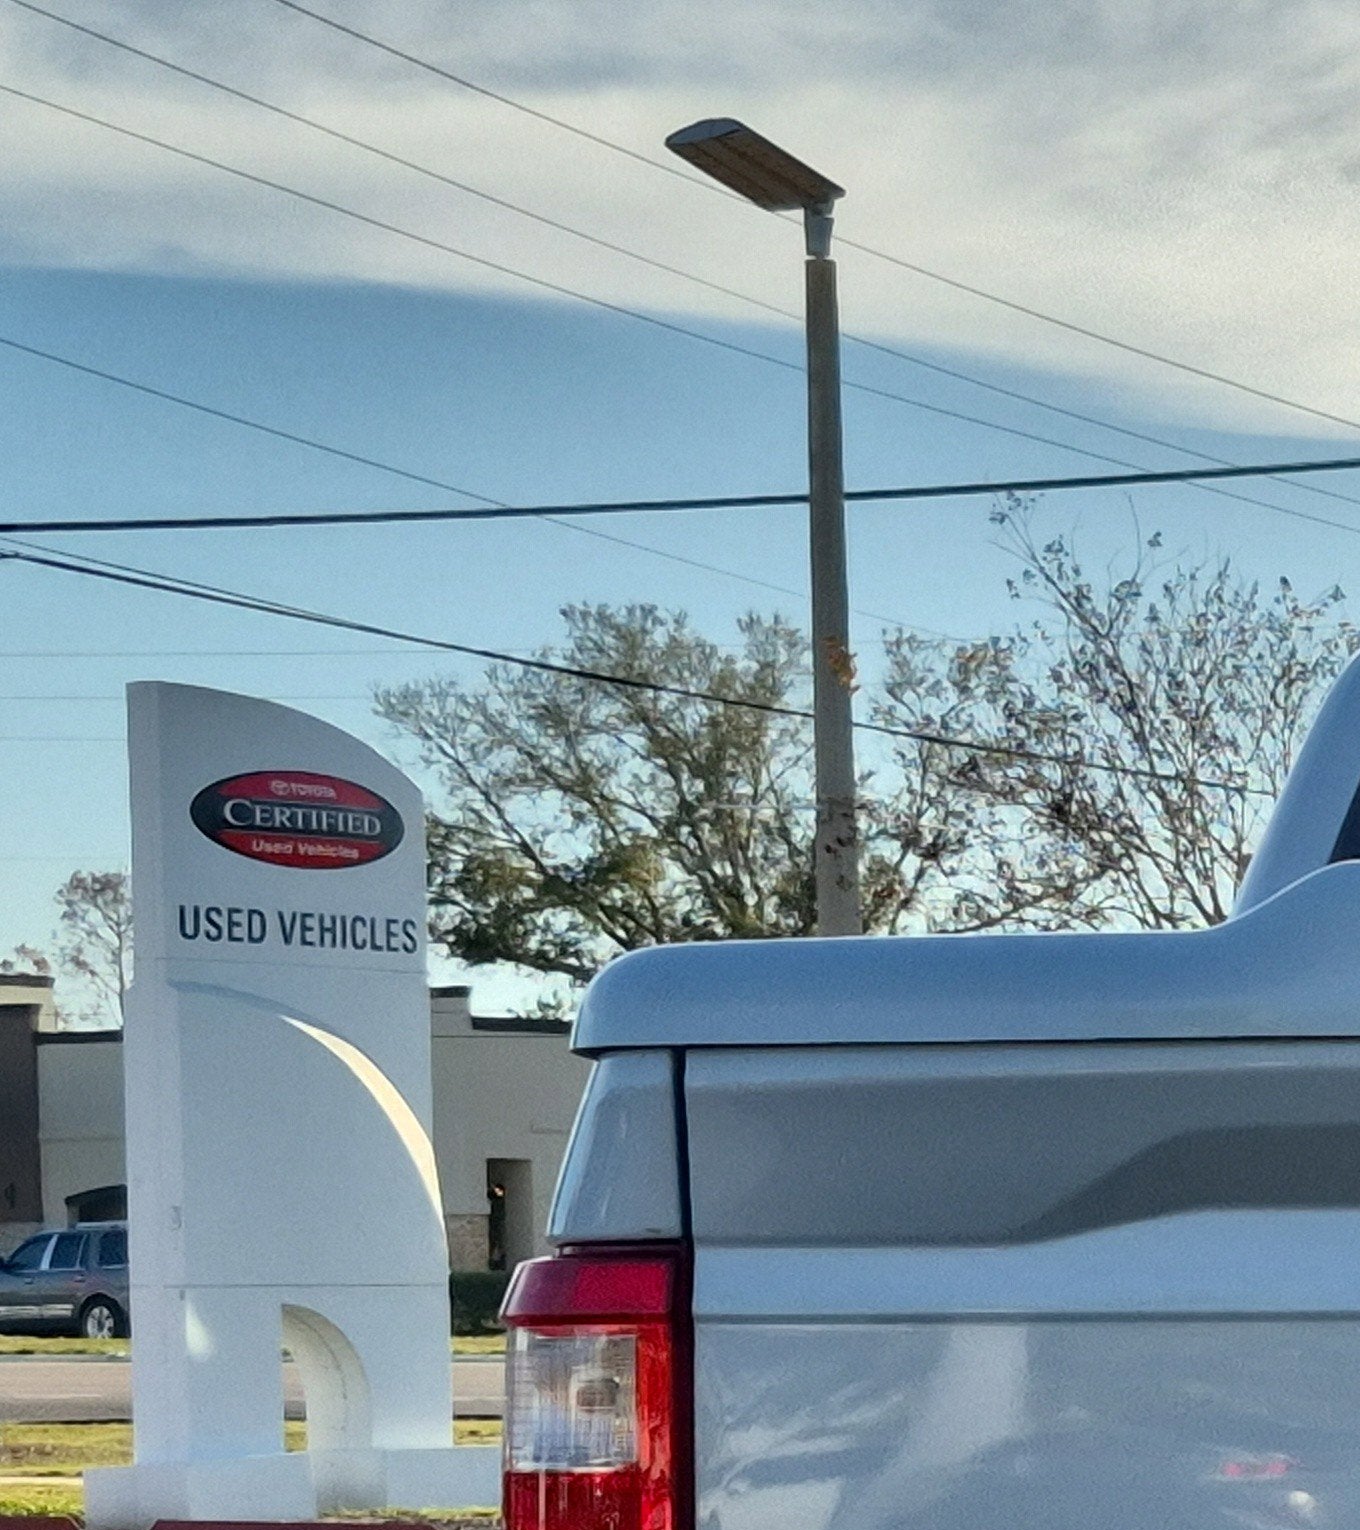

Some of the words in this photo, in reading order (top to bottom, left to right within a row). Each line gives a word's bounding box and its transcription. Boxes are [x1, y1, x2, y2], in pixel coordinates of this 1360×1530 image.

[252, 839, 293, 854] Used
[178, 904, 267, 944] USED
[277, 910, 418, 954] VEHICLES
